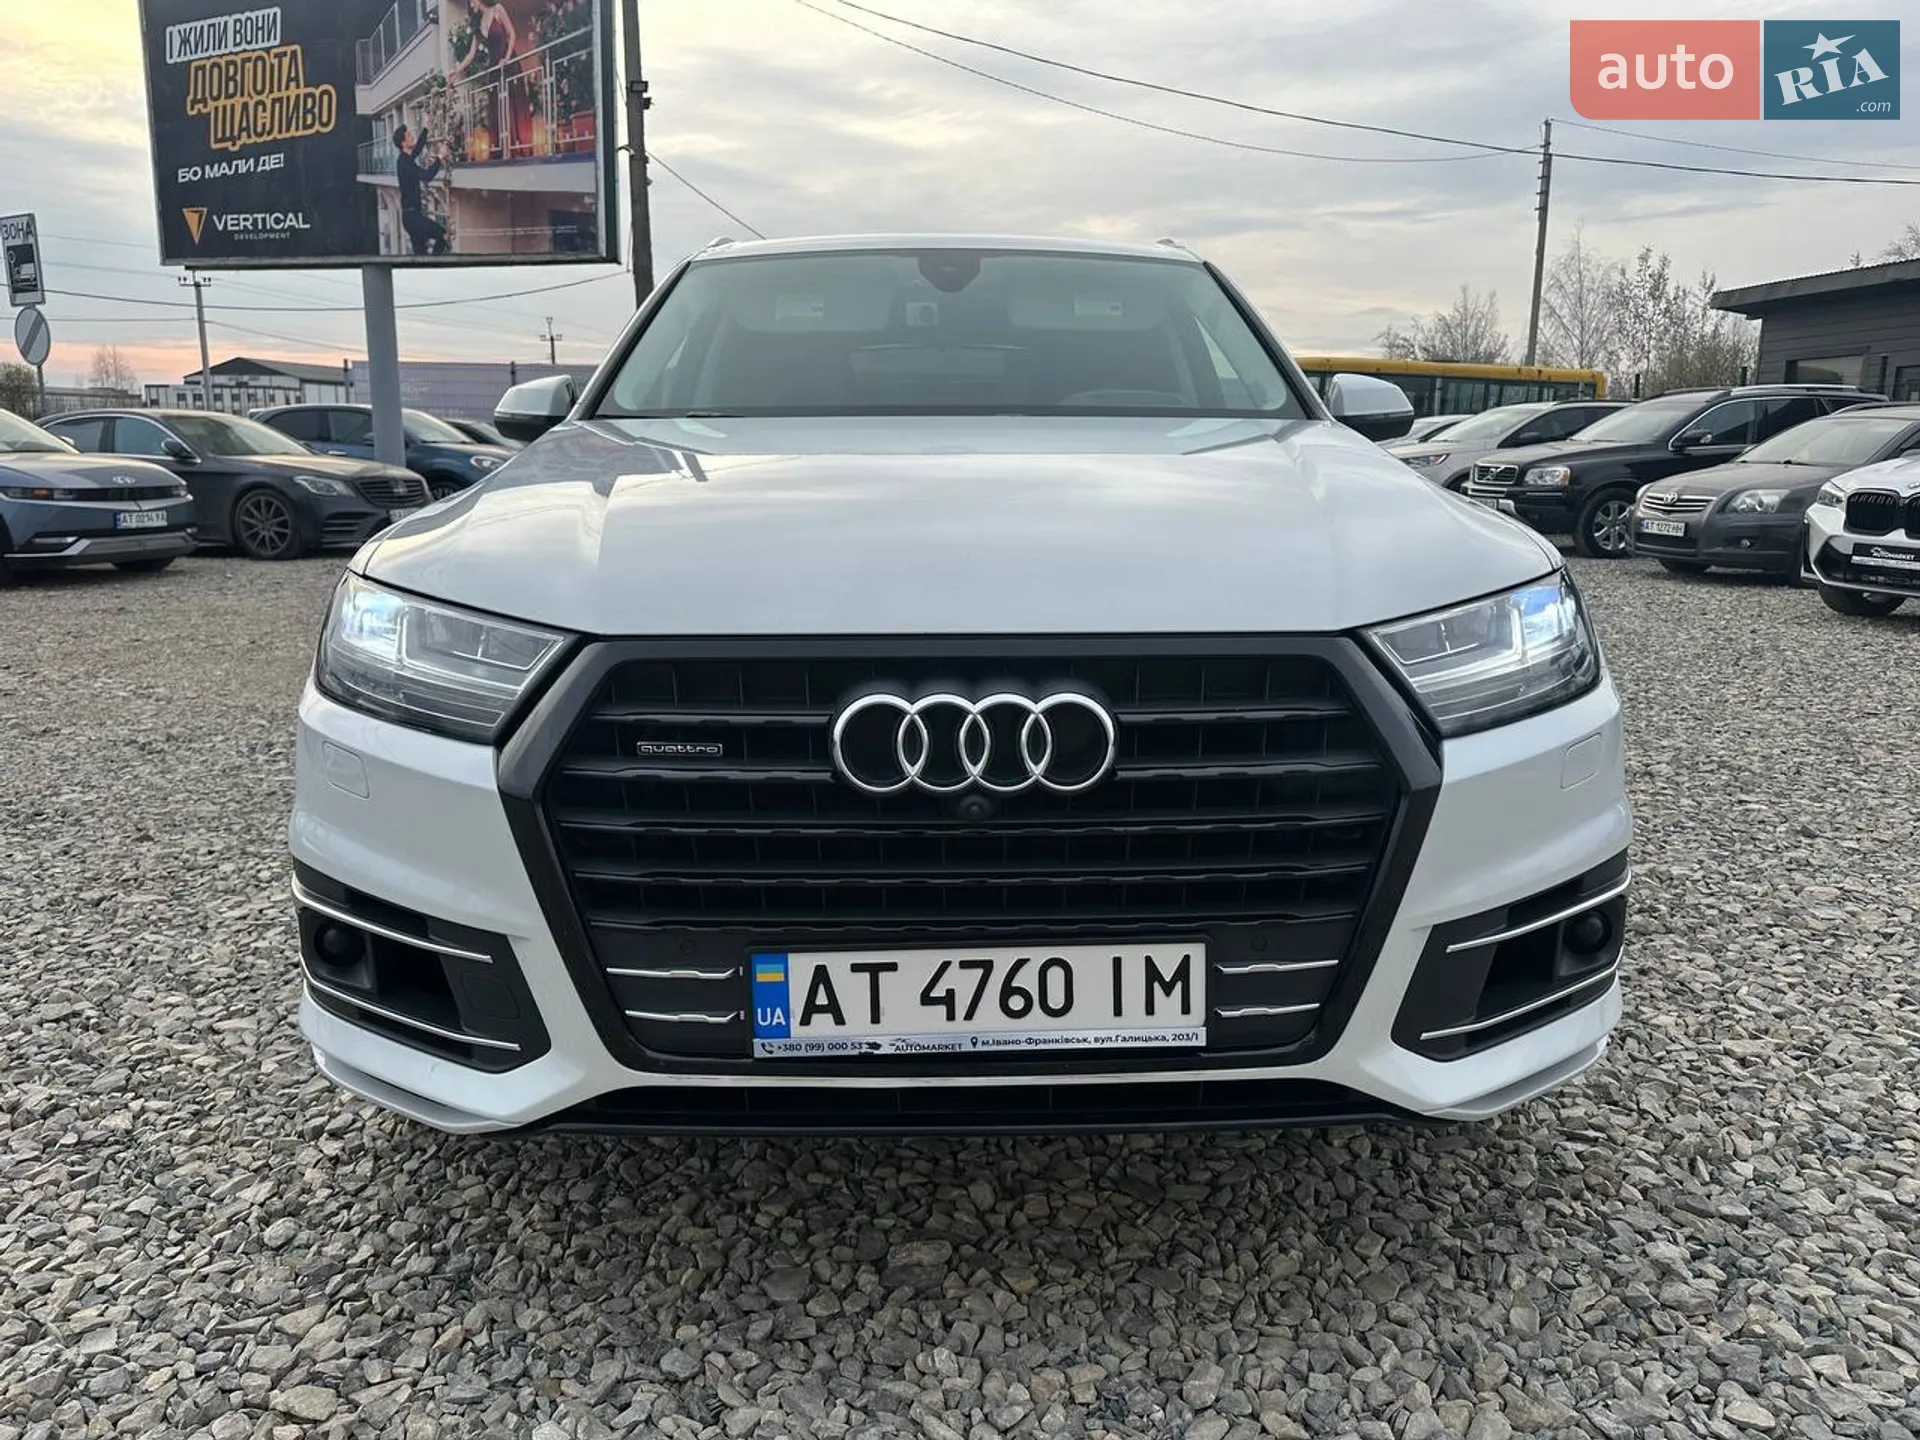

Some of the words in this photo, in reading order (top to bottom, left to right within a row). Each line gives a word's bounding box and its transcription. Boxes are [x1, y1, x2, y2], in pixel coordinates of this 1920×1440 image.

[168, 30, 175, 60] І
[177, 21, 229, 59] ЖИЛИ
[232, 11, 278, 47] ВОНИ
[189, 54, 268, 111] ДОВГО
[272, 49, 301, 93] ТА
[212, 88, 335, 147] ЩАСЛИВО
[177, 166, 201, 183] БО
[204, 158, 255, 179] МАЛИ
[256, 153, 285, 172] ДЕ!
[2, 220, 35, 241] ЗОНА
[212, 212, 311, 231] VERTICAL
[233, 232, 291, 241] DEVELOPMENT
[640, 745, 719, 753] quattro
[799, 961, 899, 1027] AT
[919, 956, 1075, 1022] 4760
[1111, 953, 1192, 1018] IM
[757, 1007, 786, 1026] UA
[1172, 1032, 1199, 1043] 203/1
[777, 1042, 802, 1052] +380
[805, 1042, 825, 1053] (99)
[828, 1042, 848, 1051] 000
[894, 1042, 964, 1053] AUTOMARKET
